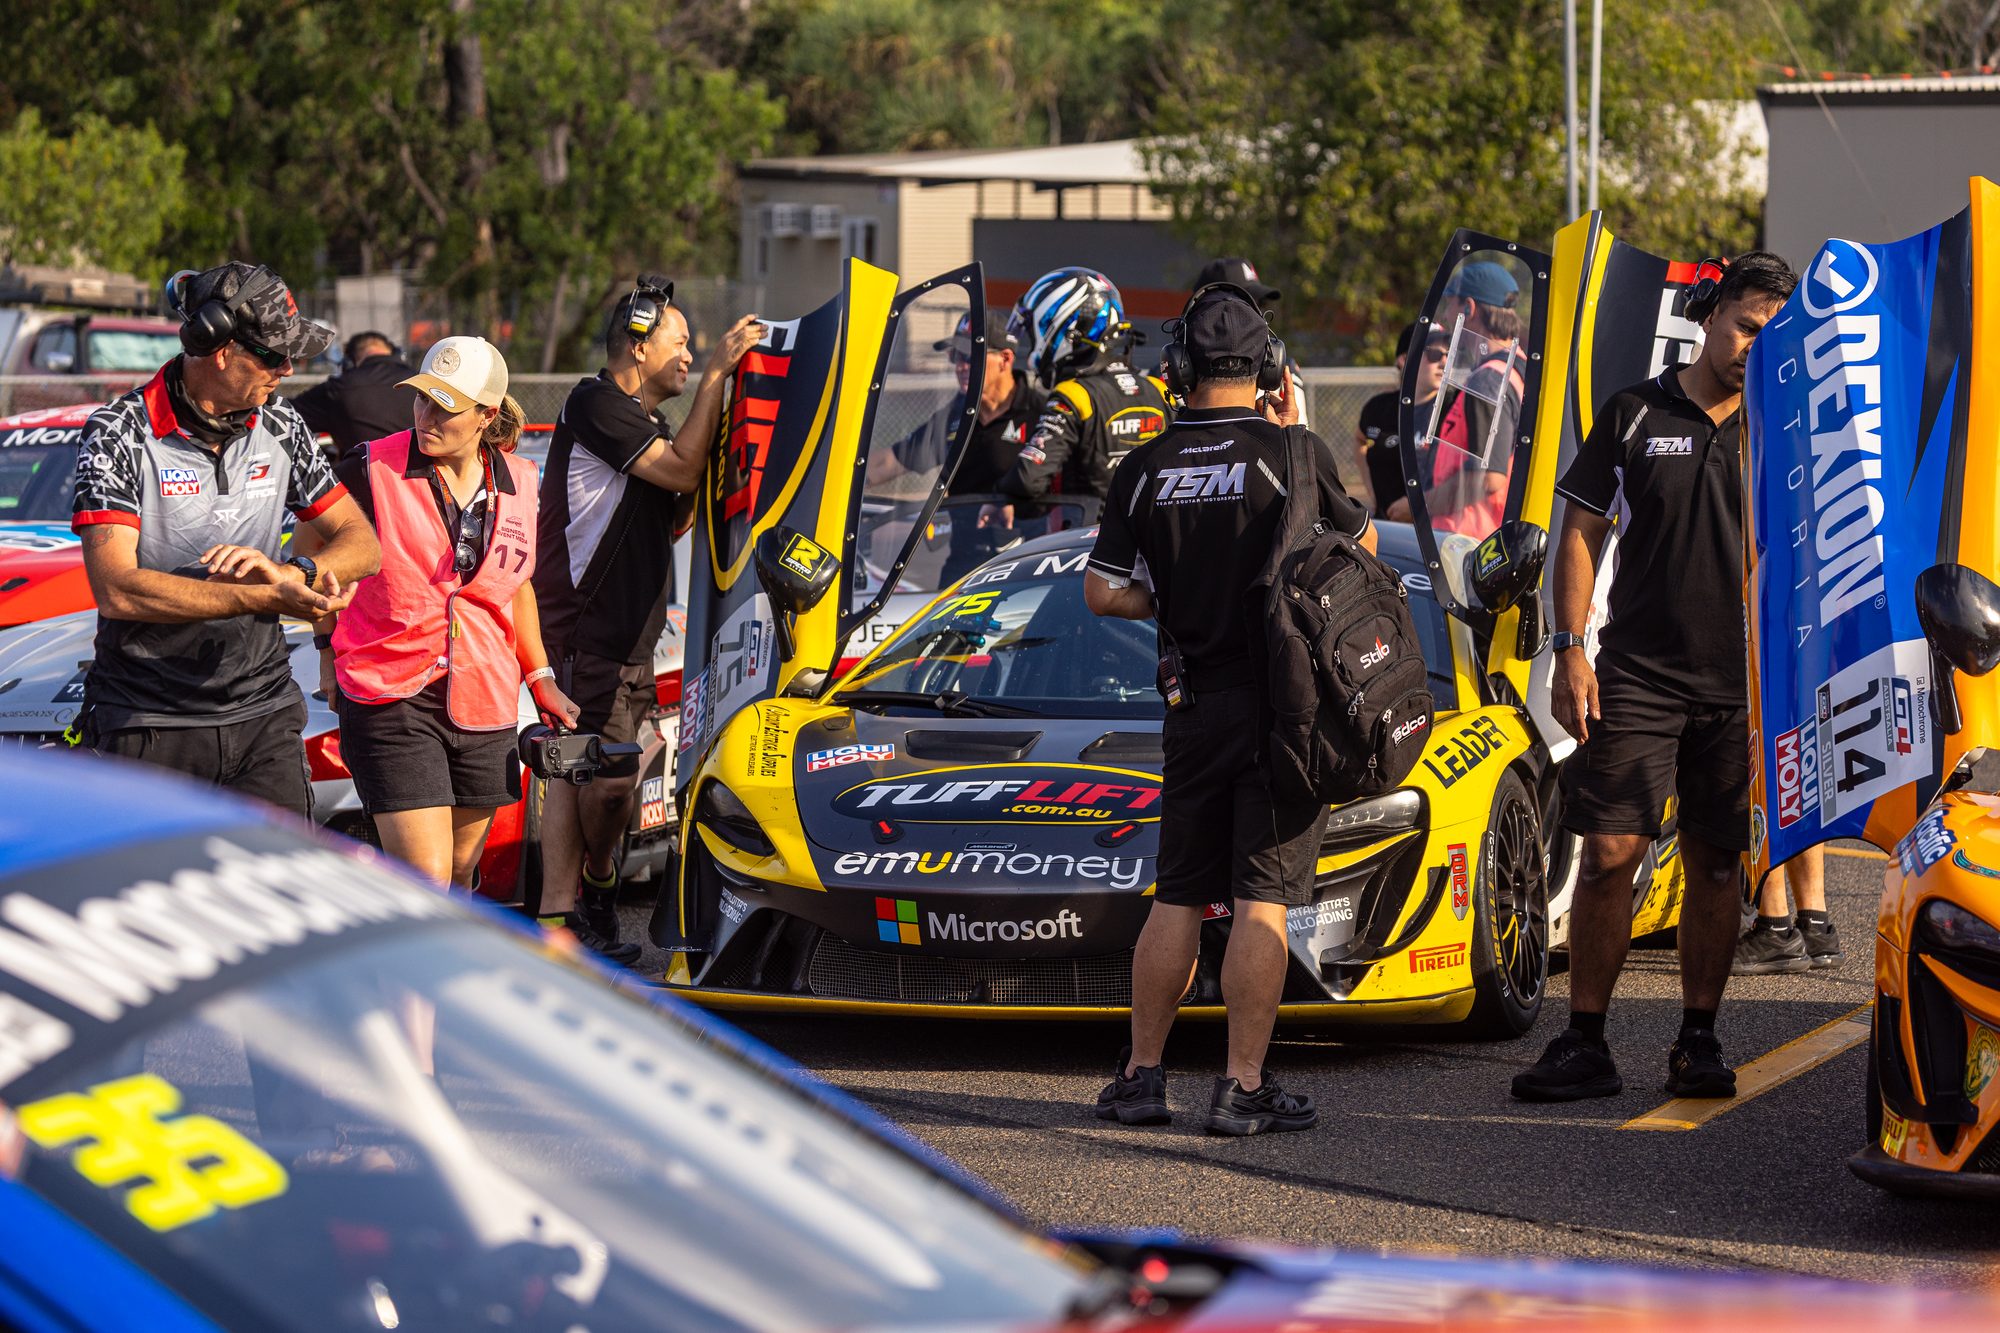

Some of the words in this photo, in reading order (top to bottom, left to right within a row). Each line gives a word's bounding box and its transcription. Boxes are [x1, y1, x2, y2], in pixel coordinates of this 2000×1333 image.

[1179, 444, 1227, 454] McLaren
[1646, 437, 1692, 453] TSM
[161, 470, 197, 482] LIQUI
[1156, 463, 1247, 500] TSM
[1803, 315, 1885, 628] DEXION
[163, 483, 199, 495] MOLY
[495, 544, 528, 574] 17
[931, 591, 1002, 621] 75
[762, 623, 774, 668] Monochrome
[1360, 636, 1390, 669] Stilo
[716, 620, 746, 704] 75
[682, 680, 700, 747] MOLY
[695, 668, 710, 738] LIQUI
[1883, 684, 1893, 746] AUSTRALIA
[1917, 687, 1926, 744] Monochrome
[1833, 678, 1886, 793] 114
[812, 745, 889, 761] LIQUI
[812, 752, 892, 769] MOLY
[1422, 716, 1510, 789] LEADER
[1801, 716, 1818, 812] LIQUI
[1778, 733, 1800, 818] MOLY
[1821, 741, 1834, 801] SILVER
[643, 780, 662, 799] LIQUI
[856, 780, 1161, 809] TUFFLIFT
[641, 803, 664, 827] MOLY
[1002, 803, 1112, 819] .com.au
[834, 851, 1143, 889] emumoney
[1451, 853, 1468, 908] BRM
[1285, 897, 1351, 919] RTALOTTA'S
[1286, 909, 1353, 933] NLOADING
[928, 909, 1083, 941] Microsoft
[1408, 942, 1466, 973] PIRELLI
